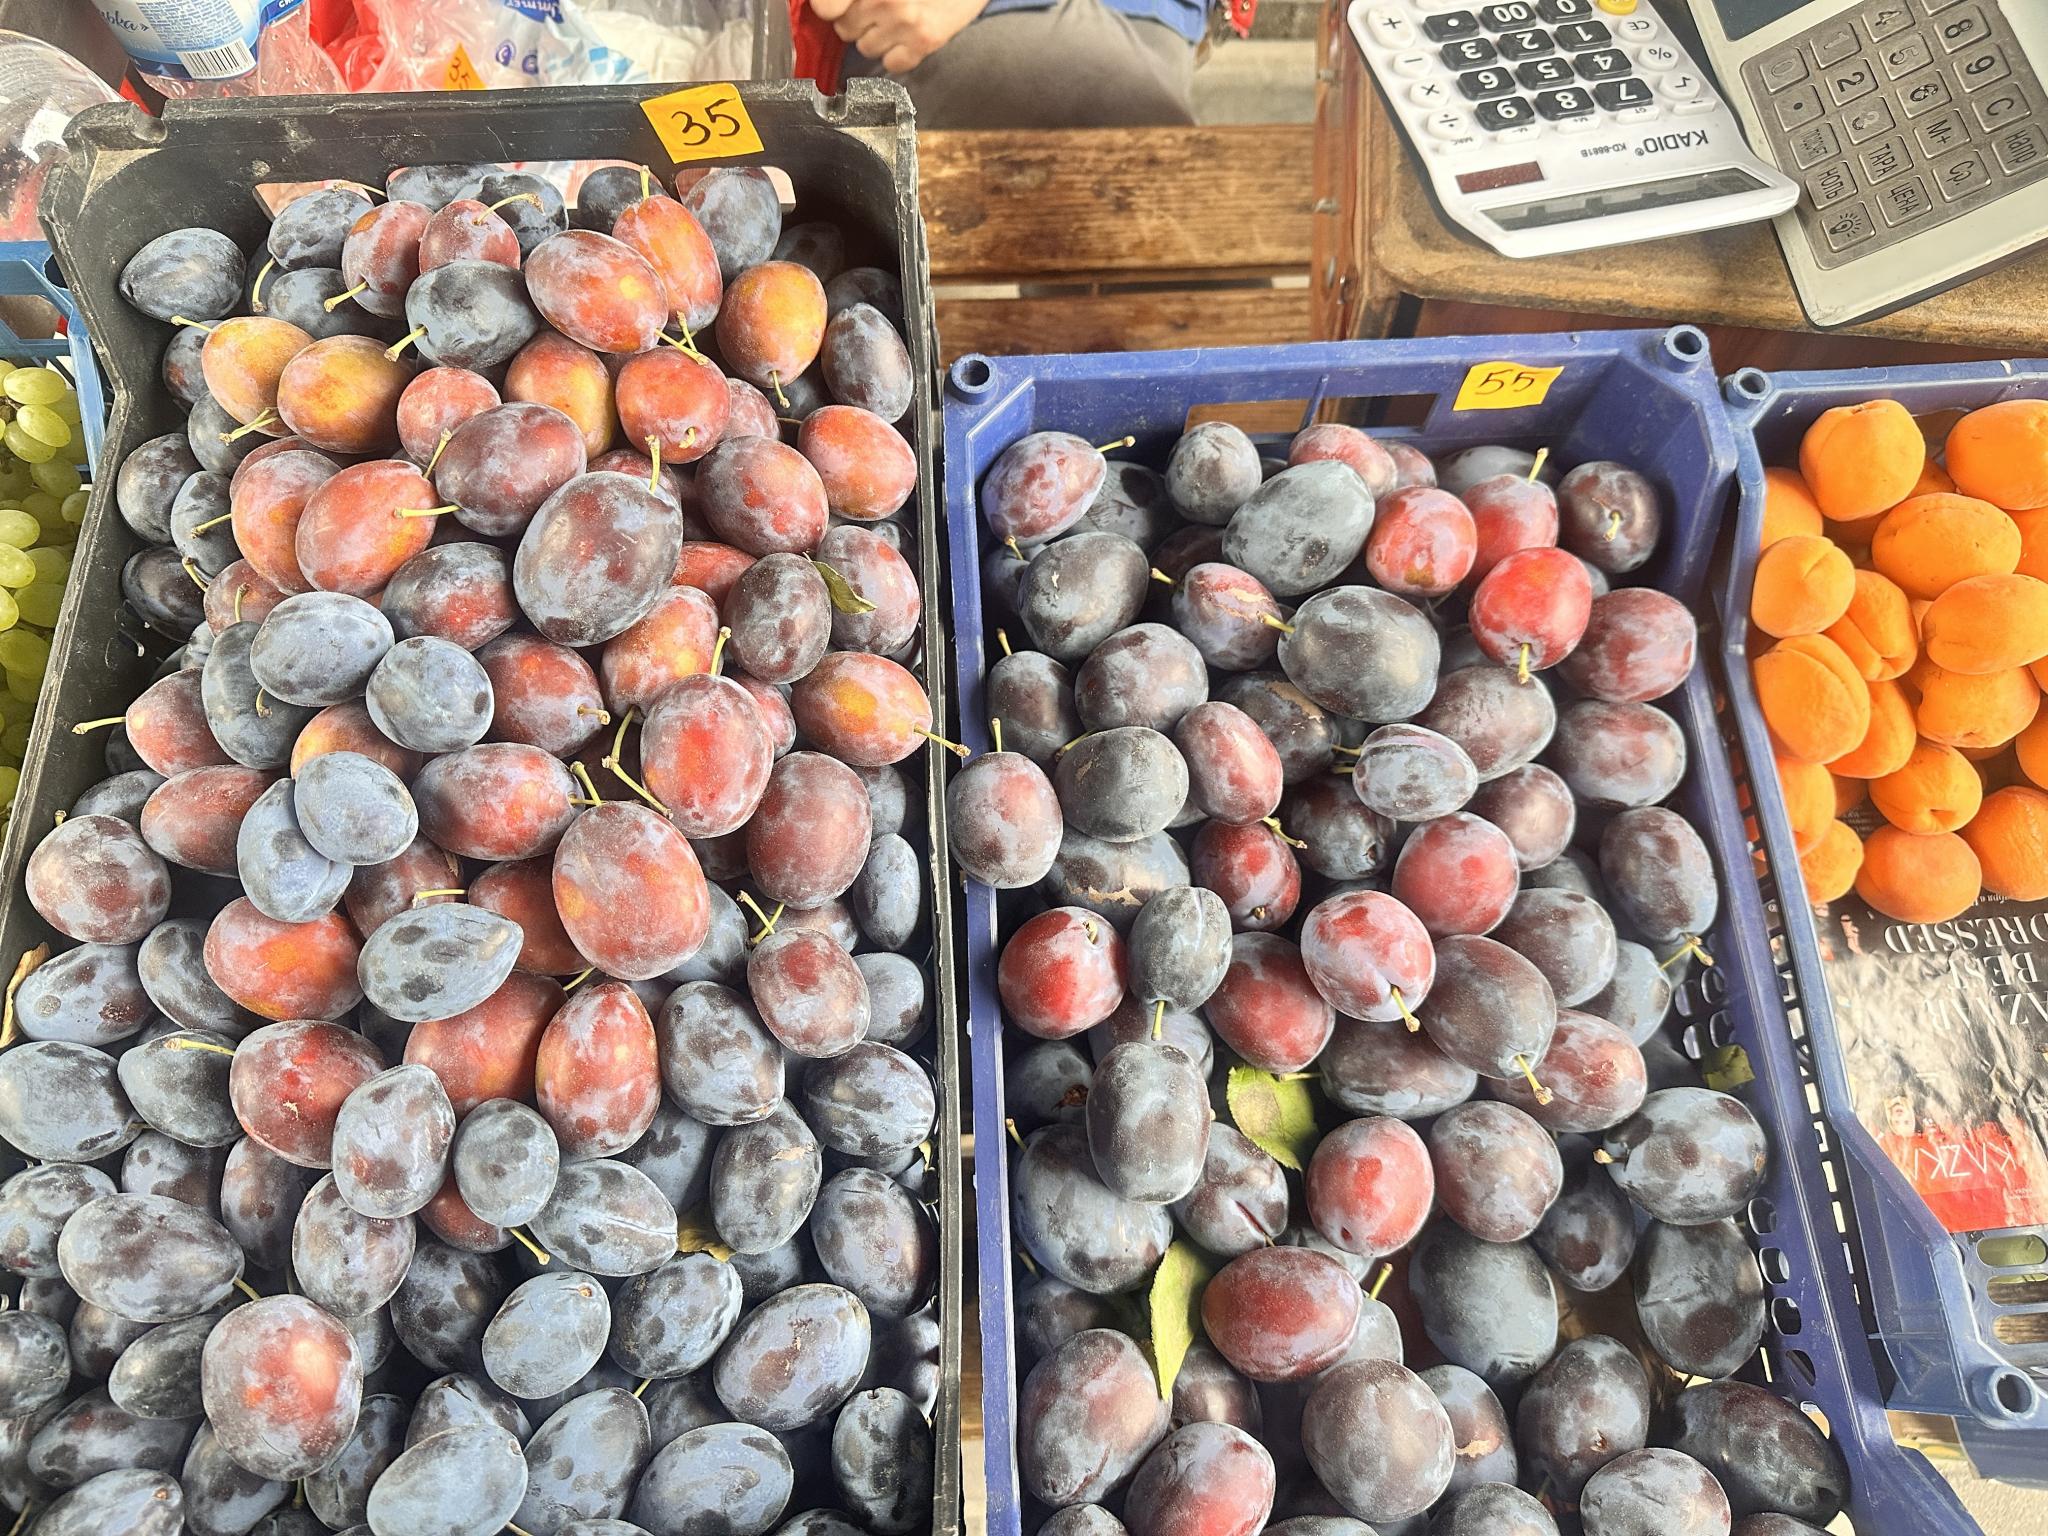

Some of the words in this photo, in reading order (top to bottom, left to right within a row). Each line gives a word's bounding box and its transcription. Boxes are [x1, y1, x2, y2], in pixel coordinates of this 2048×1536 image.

[1493, 4, 1527, 22] 00
[1556, 0, 1576, 14] 0
[1575, 26, 1593, 42] 1
[1627, 20, 1650, 31] CE
[1944, 18, 1974, 39] 8
[1461, 42, 1482, 59] 3
[1516, 33, 1540, 49] 2
[1592, 54, 1613, 70] 4
[1889, 45, 1920, 66] 5
[1966, 55, 1995, 75] 9
[1478, 71, 1499, 89] 6
[1537, 62, 1559, 79] 5
[1837, 71, 1865, 93] 2
[1555, 91, 1578, 109] 8
[1619, 83, 1638, 101] 7
[1910, 83, 1939, 103] 6
[1497, 101, 1518, 119] 9
[671, 98, 740, 146] 35
[1926, 119, 1952, 145] M+
[1868, 143, 1898, 178] ТАРА
[1887, 182, 1920, 216] ЦЕНА
[1475, 369, 1540, 395] 55
[1884, 912, 2048, 954] DRESSED
[1948, 951, 2043, 990] BEST
